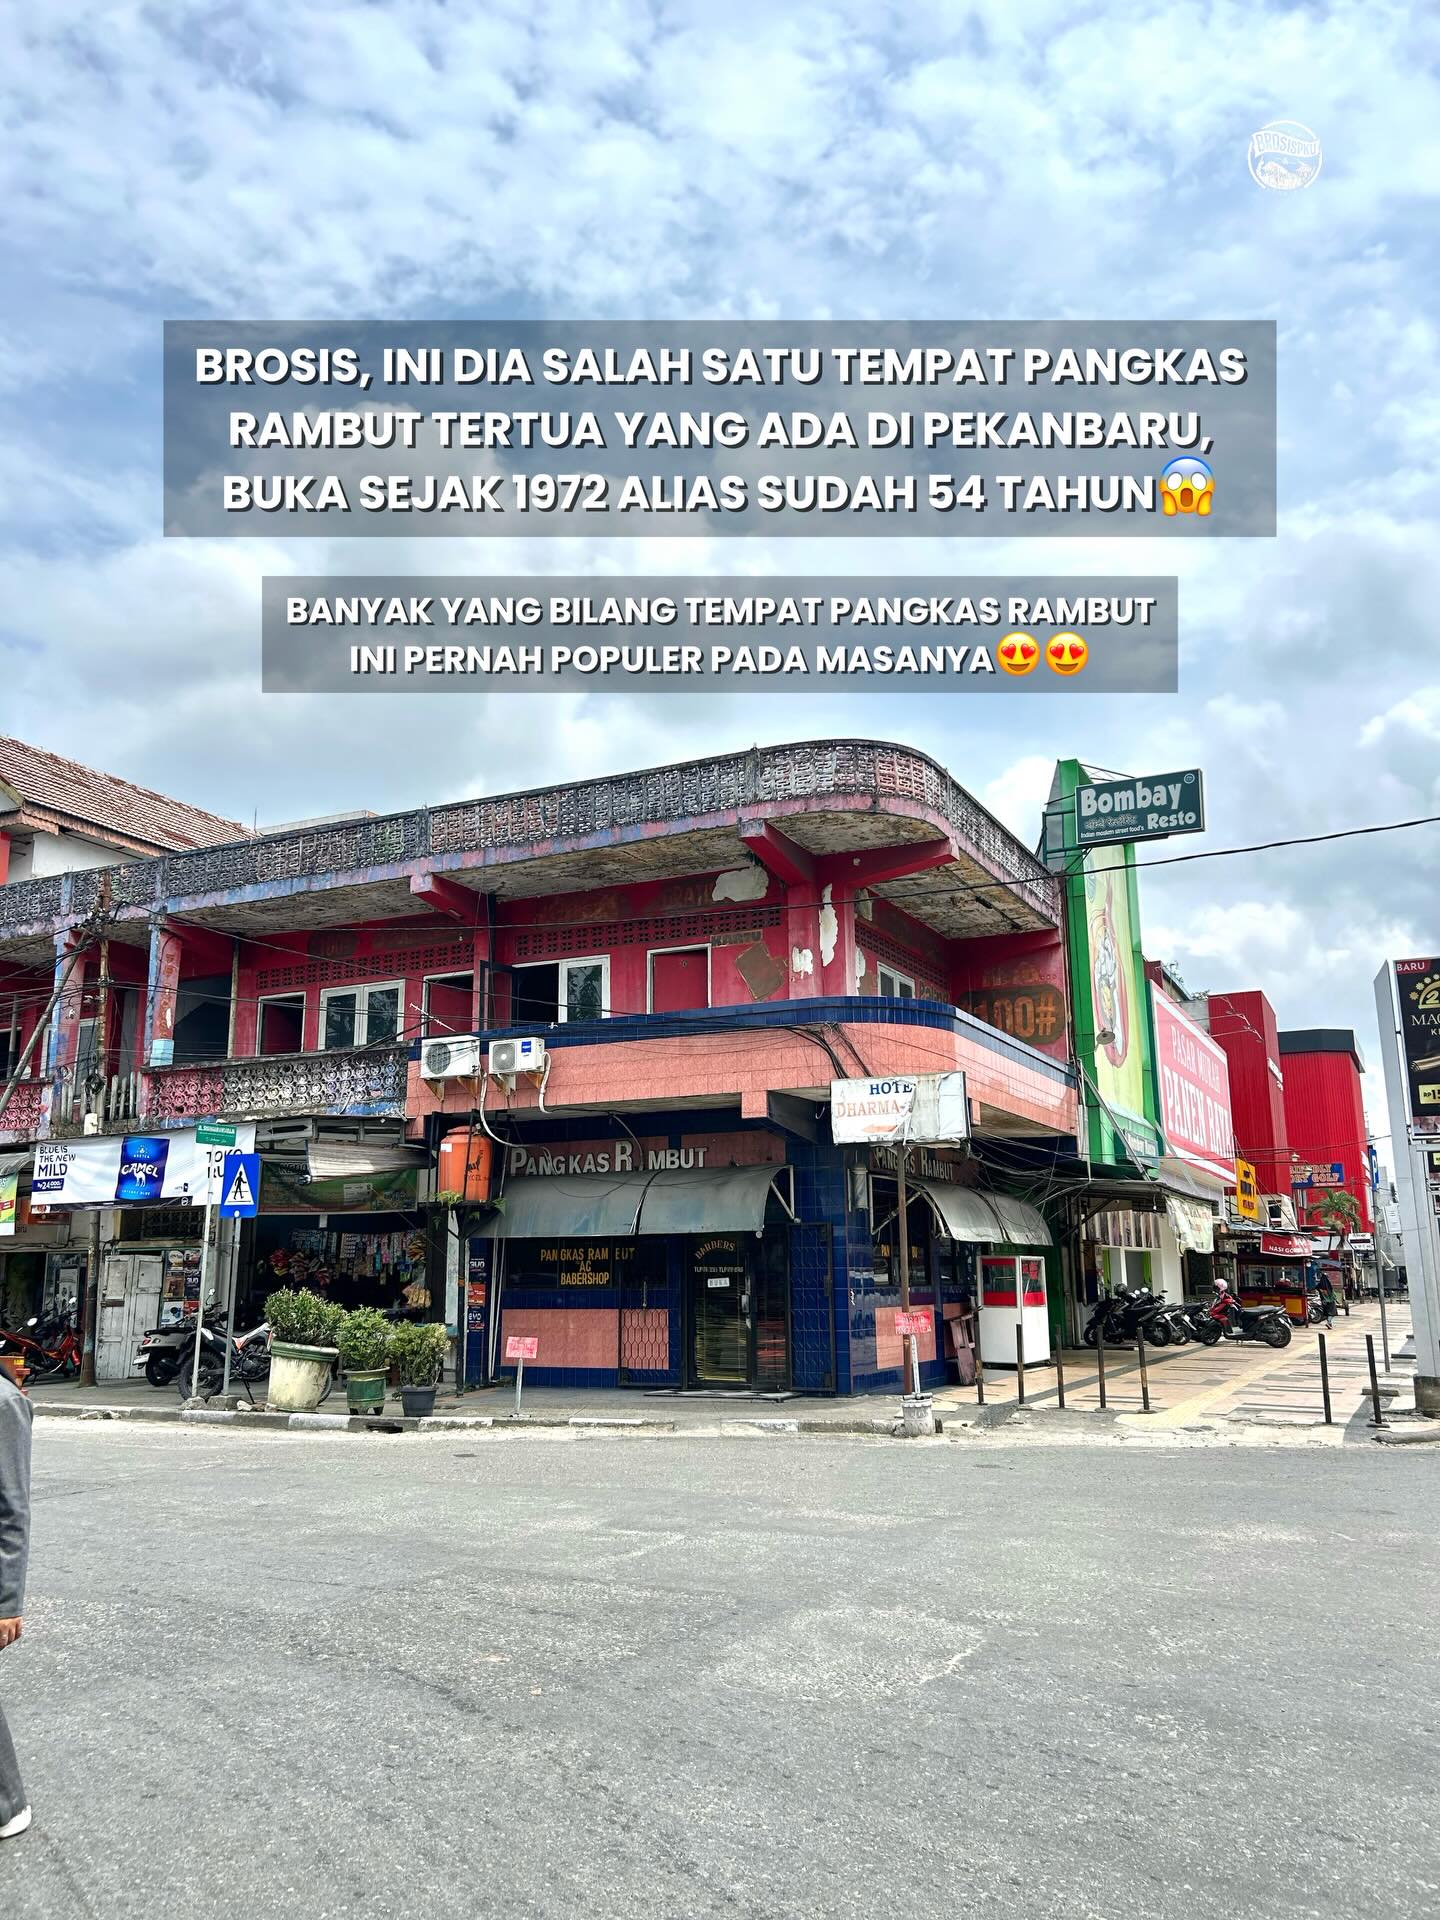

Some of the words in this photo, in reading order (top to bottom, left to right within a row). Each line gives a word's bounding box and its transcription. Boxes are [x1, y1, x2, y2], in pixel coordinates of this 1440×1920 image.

[1080, 781, 1182, 817] Bombay
[1146, 811, 1197, 830] Resto
[1396, 961, 1425, 972] BARU
[1170, 1025, 1198, 1076] PASAR
[1163, 1064, 1208, 1149] PANEN
[39, 1145, 59, 1155] BLUE
[60, 1145, 68, 1153] IS
[39, 1155, 54, 1163] THE
[54, 1153, 76, 1163] NEW
[509, 1146, 610, 1177] PANGKAS
[873, 1146, 916, 1175] PANGAS
[921, 1147, 953, 1181] RAMBUT
[38, 1163, 68, 1178] MILD
[121, 1162, 159, 1178] CAMEL
[1311, 1172, 1341, 1184] GOLF
[694, 1239, 736, 1261] BARBERS
[1268, 1245, 1285, 1253] NASI
[578, 1261, 592, 1272] AC
[560, 1271, 610, 1286] BABERSHOP
